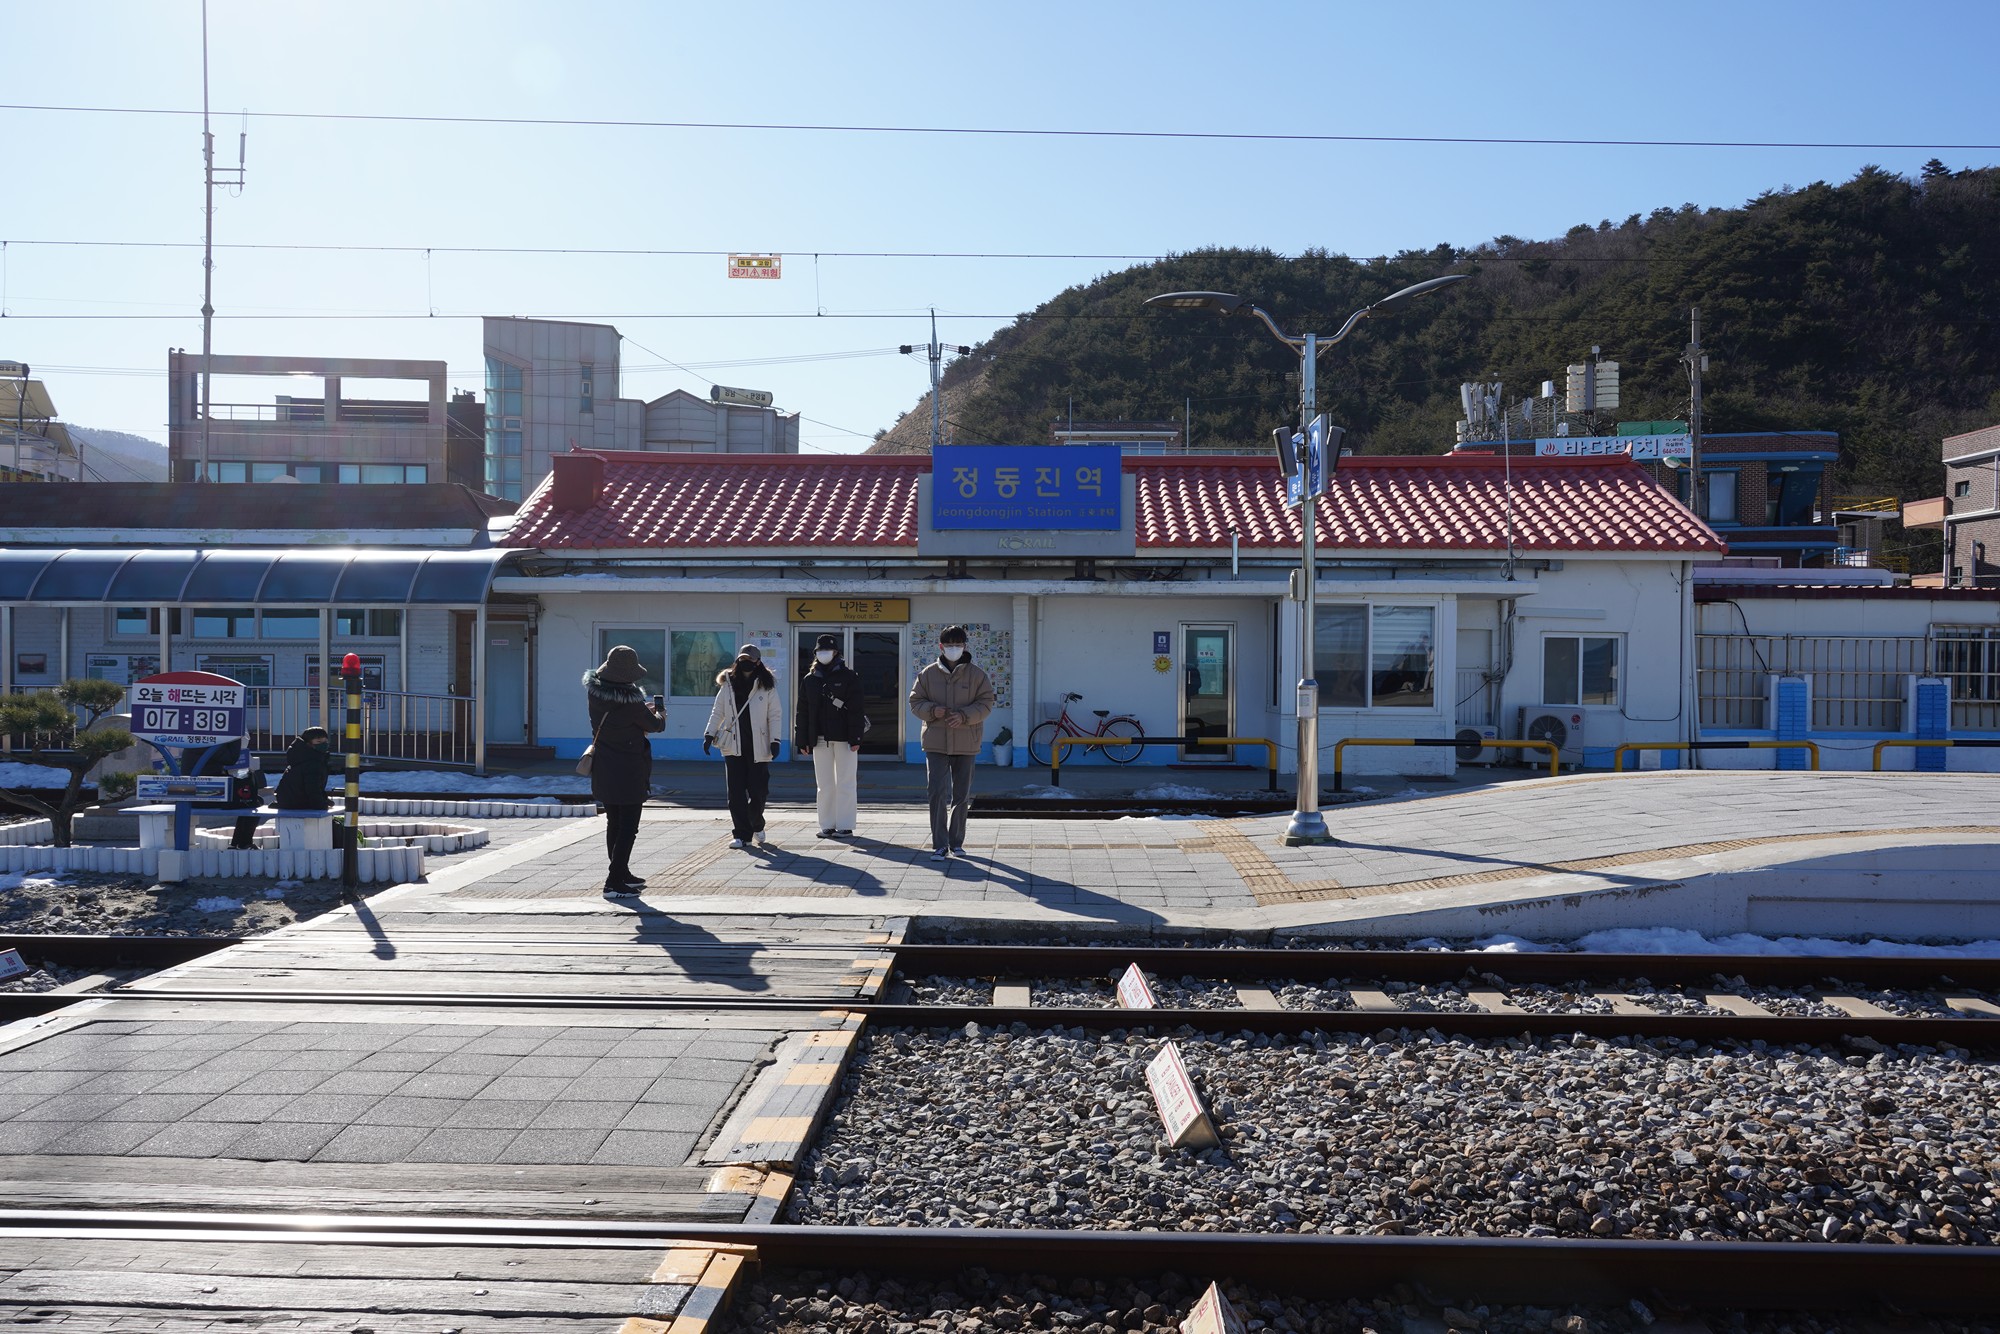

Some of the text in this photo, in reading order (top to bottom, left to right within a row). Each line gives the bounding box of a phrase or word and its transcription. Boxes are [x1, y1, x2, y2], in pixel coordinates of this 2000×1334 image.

[731, 268, 778, 277] 전기 위험
[1564, 439, 1659, 457] 바다비치
[952, 466, 1102, 498] 정동진역
[937, 506, 1072, 519] Jeongdongjin Station
[998, 536, 1056, 549] KORAIL
[840, 601, 882, 613] 나가는 곳
[137, 687, 237, 704] 오늘 해뜨는 시각
[154, 734, 184, 743] KORAIL
[187, 735, 217, 743] 정동진역
